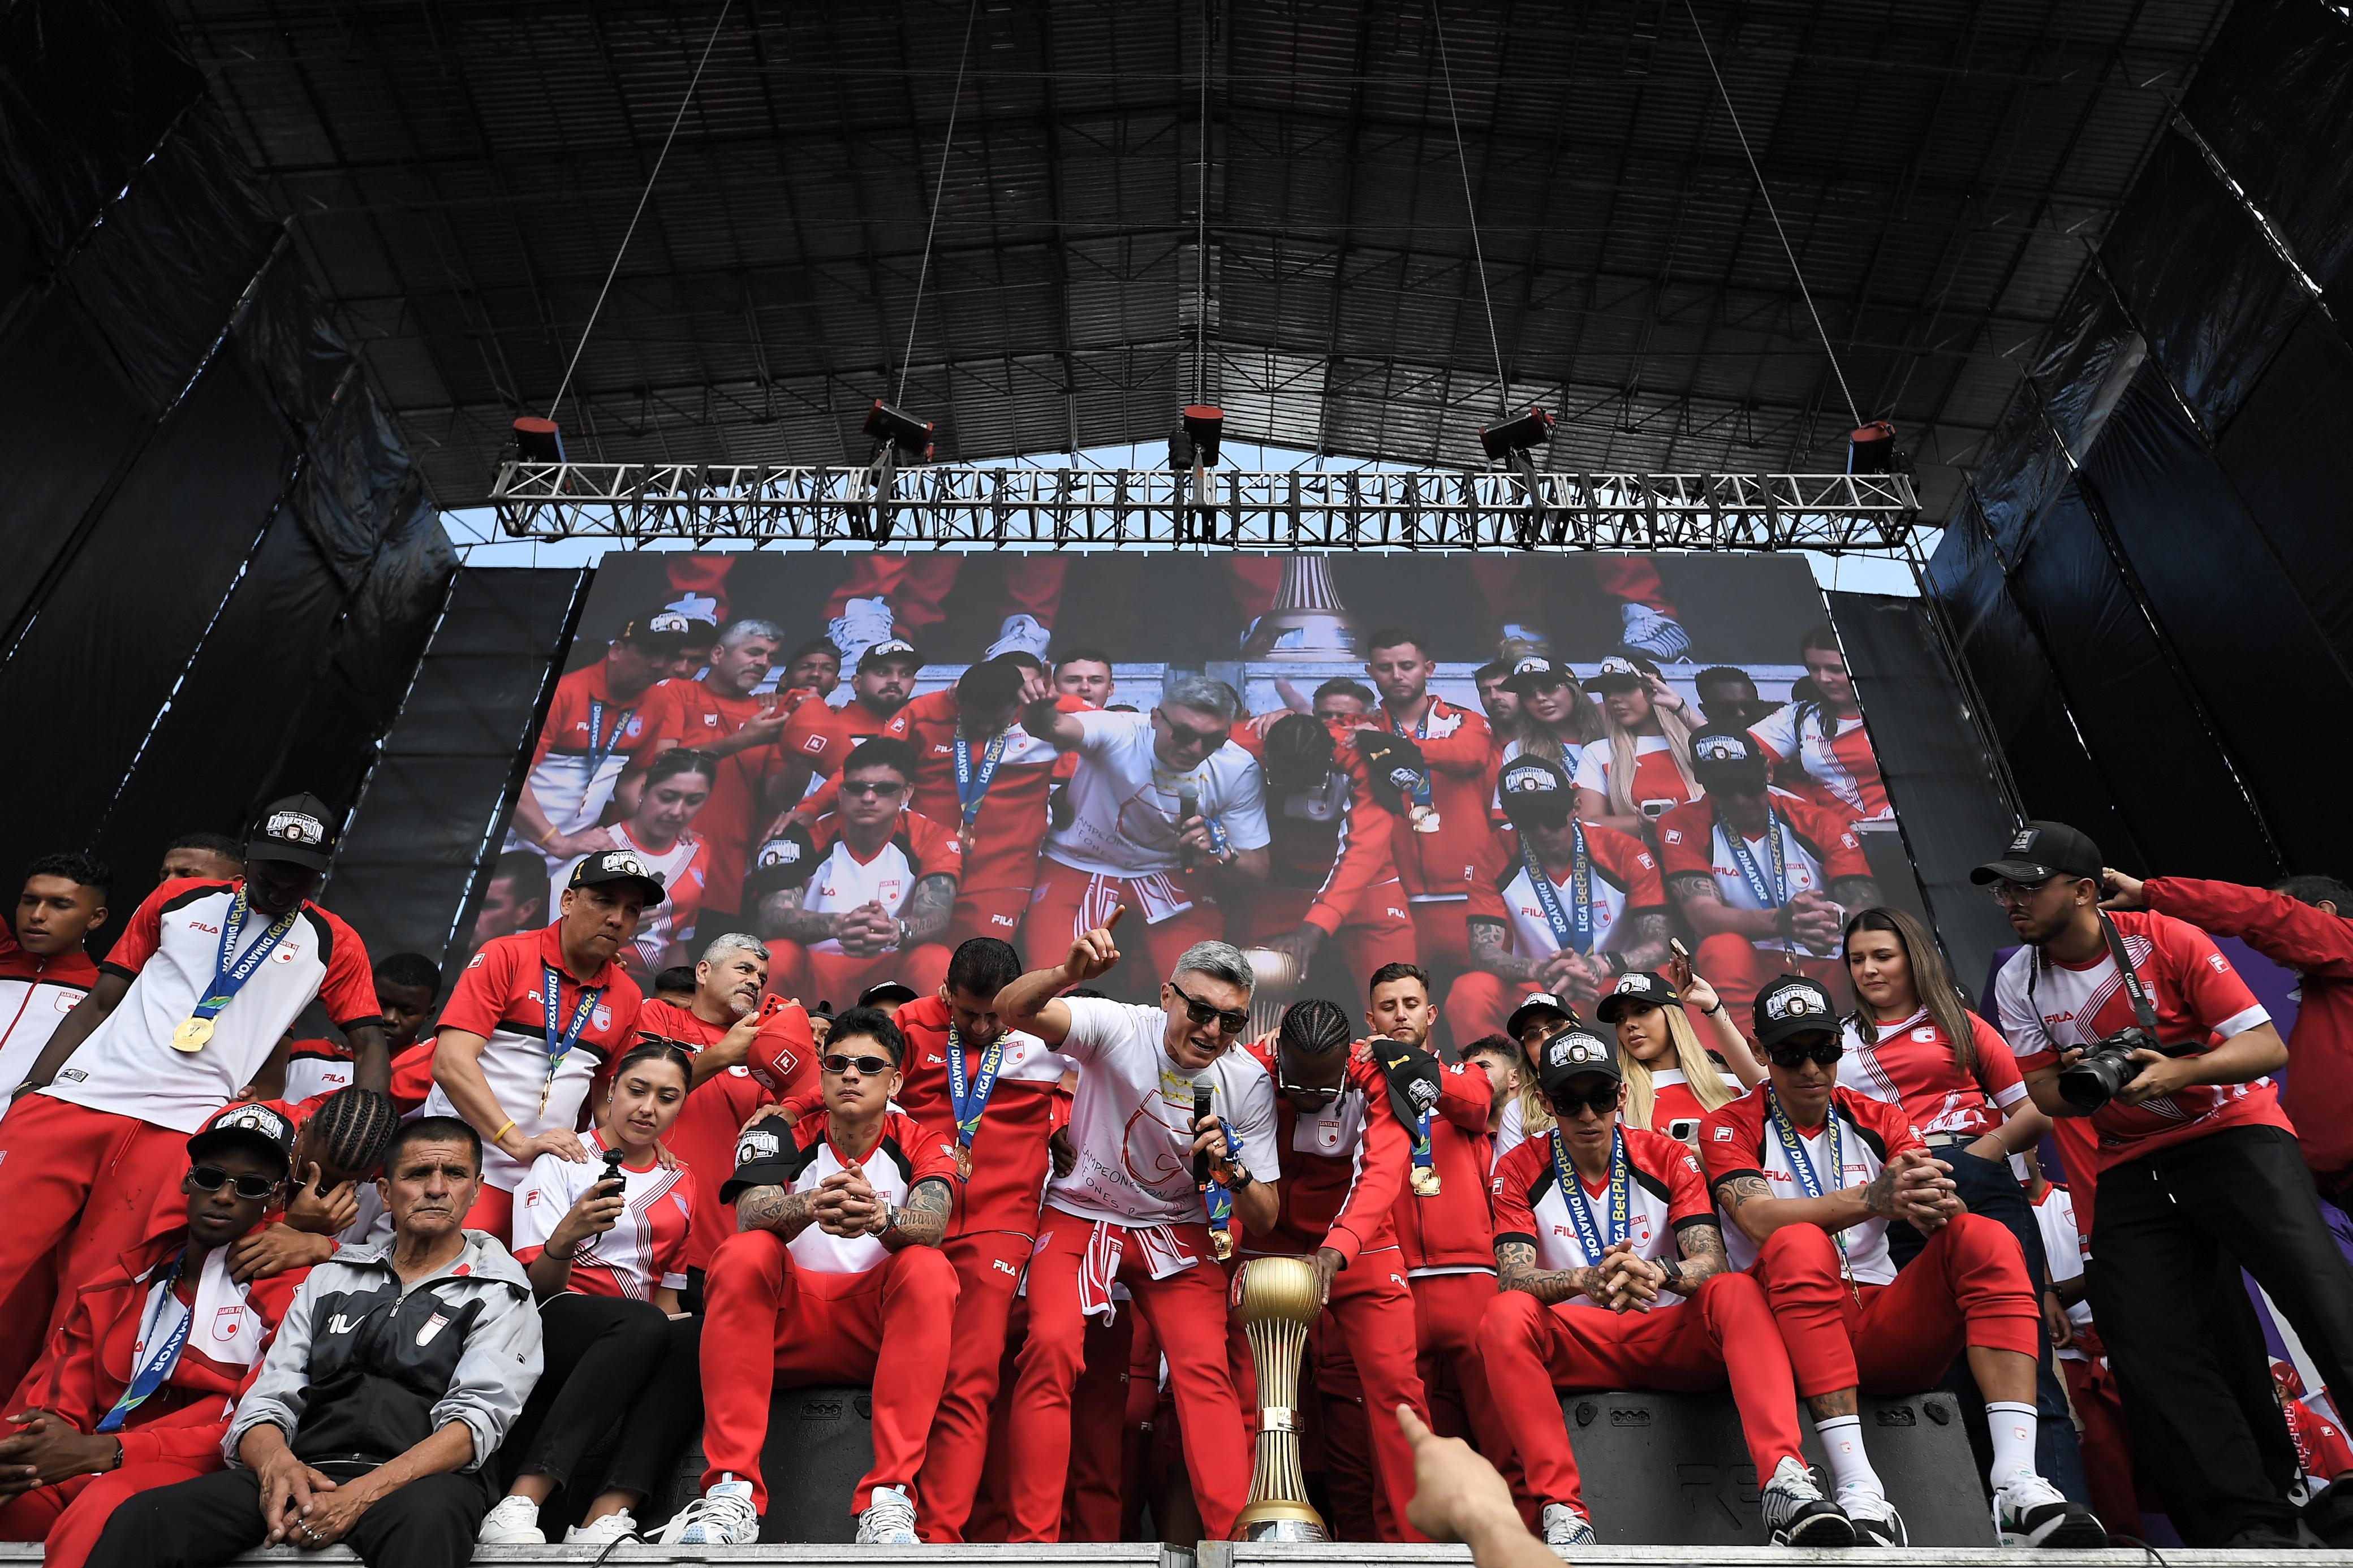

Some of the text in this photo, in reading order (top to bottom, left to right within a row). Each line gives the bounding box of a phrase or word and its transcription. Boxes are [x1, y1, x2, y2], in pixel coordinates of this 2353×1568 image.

[979, 762, 995, 784] LIGA
[1573, 853, 1588, 905] BetPlay
[1712, 867, 1739, 876] FILA
[1537, 882, 1567, 934] DIMAYOR
[1578, 905, 1588, 932] LIGA
[189, 921, 218, 934] FILA
[232, 936, 275, 980] DIMAYOR
[2125, 972, 2141, 998] Canon
[549, 975, 558, 1030] DIMAYOR
[568, 1016, 585, 1039] LIGA
[2044, 1010, 2075, 1026] FILA
[321, 1073, 345, 1083] FILA
[950, 1049, 964, 1098] DIMAYOR
[975, 1074, 992, 1100] LIGA
[1764, 1170, 1792, 1182] FILA
[1790, 1150, 1820, 1199] DIMAYO
[1611, 1159, 1627, 1221] BetPlay
[1570, 1196, 1601, 1258] DIMAYOR
[993, 1259, 1016, 1277] FILA
